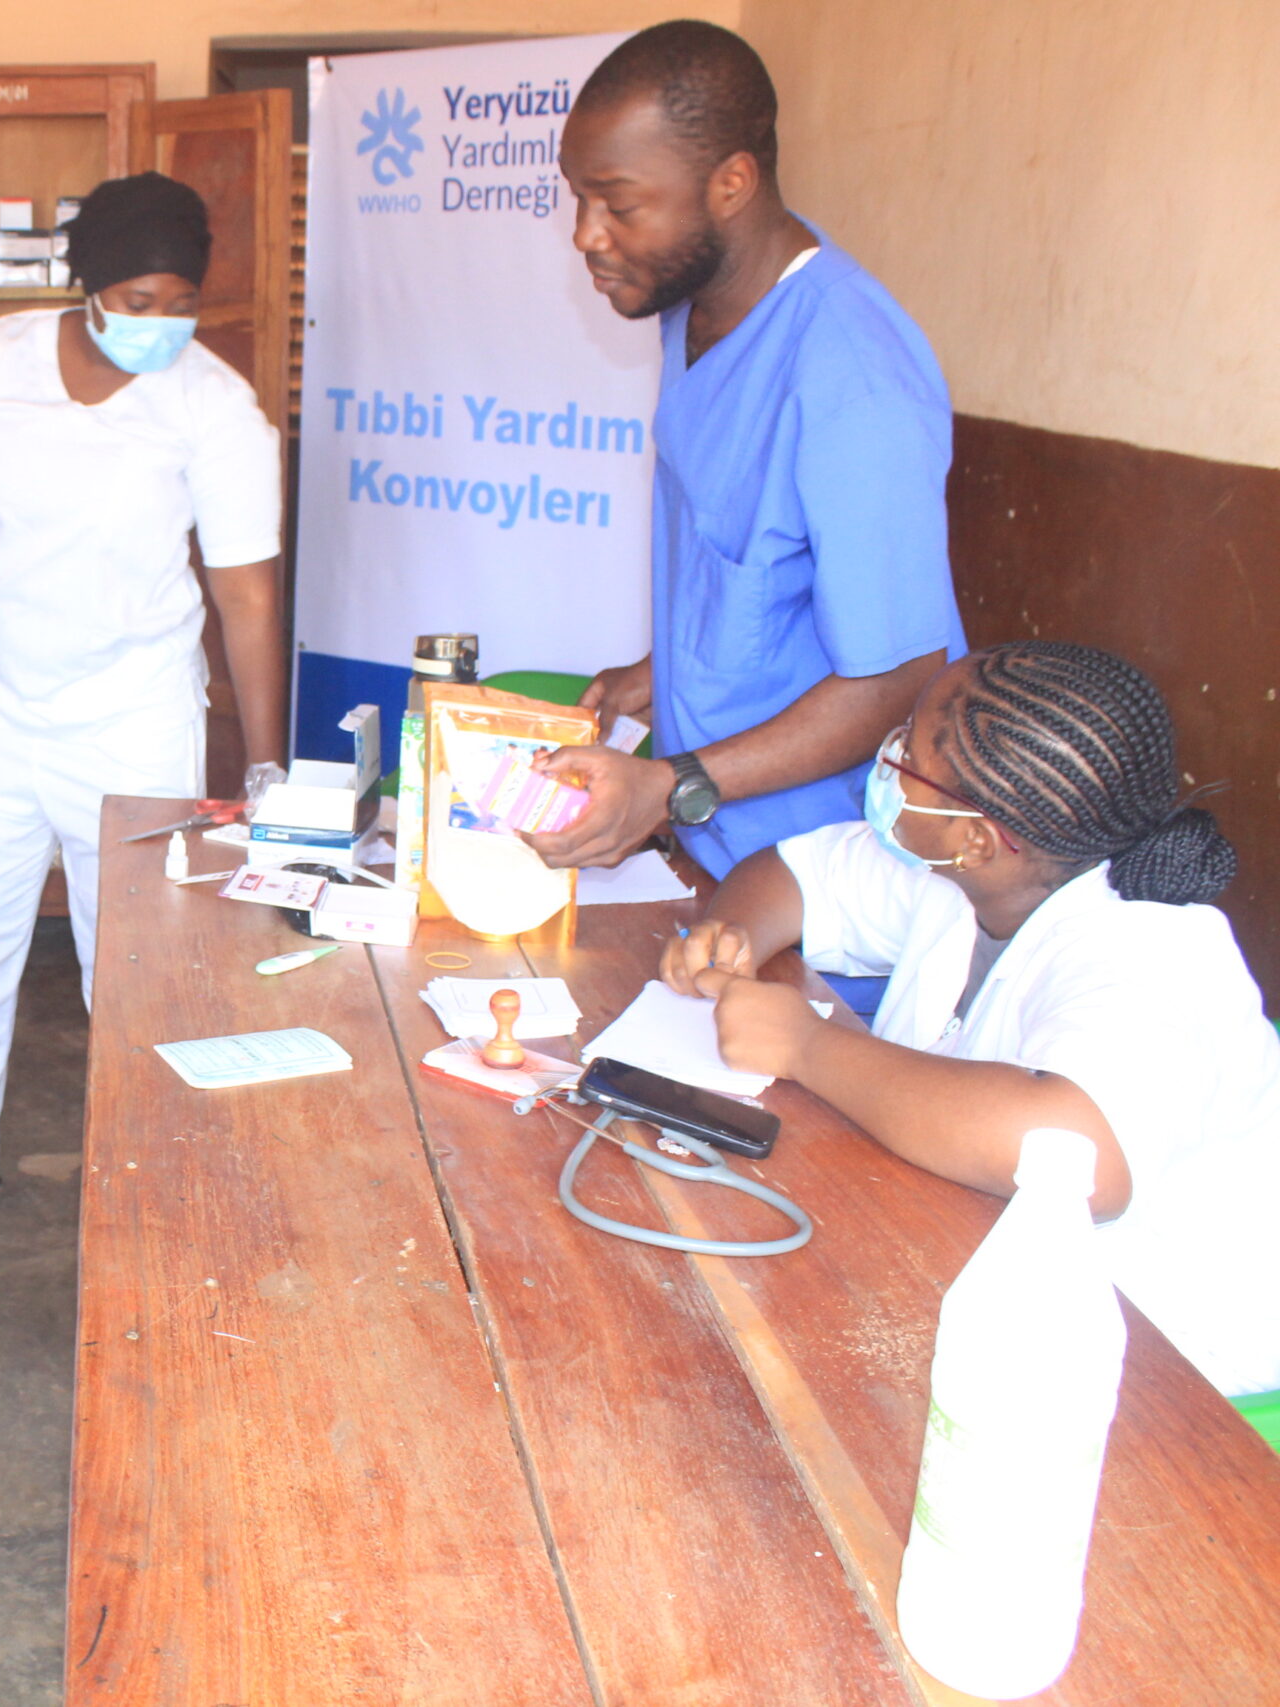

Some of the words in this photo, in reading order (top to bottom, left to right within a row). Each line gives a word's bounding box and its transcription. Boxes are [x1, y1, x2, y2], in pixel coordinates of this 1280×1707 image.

[442, 79, 570, 125] Yeryüzü
[442, 128, 562, 168] Yardıml
[358, 195, 421, 214] WWHO
[442, 174, 560, 217] Derneği
[327, 388, 444, 438] Tıbbi
[464, 395, 645, 454] Yardım
